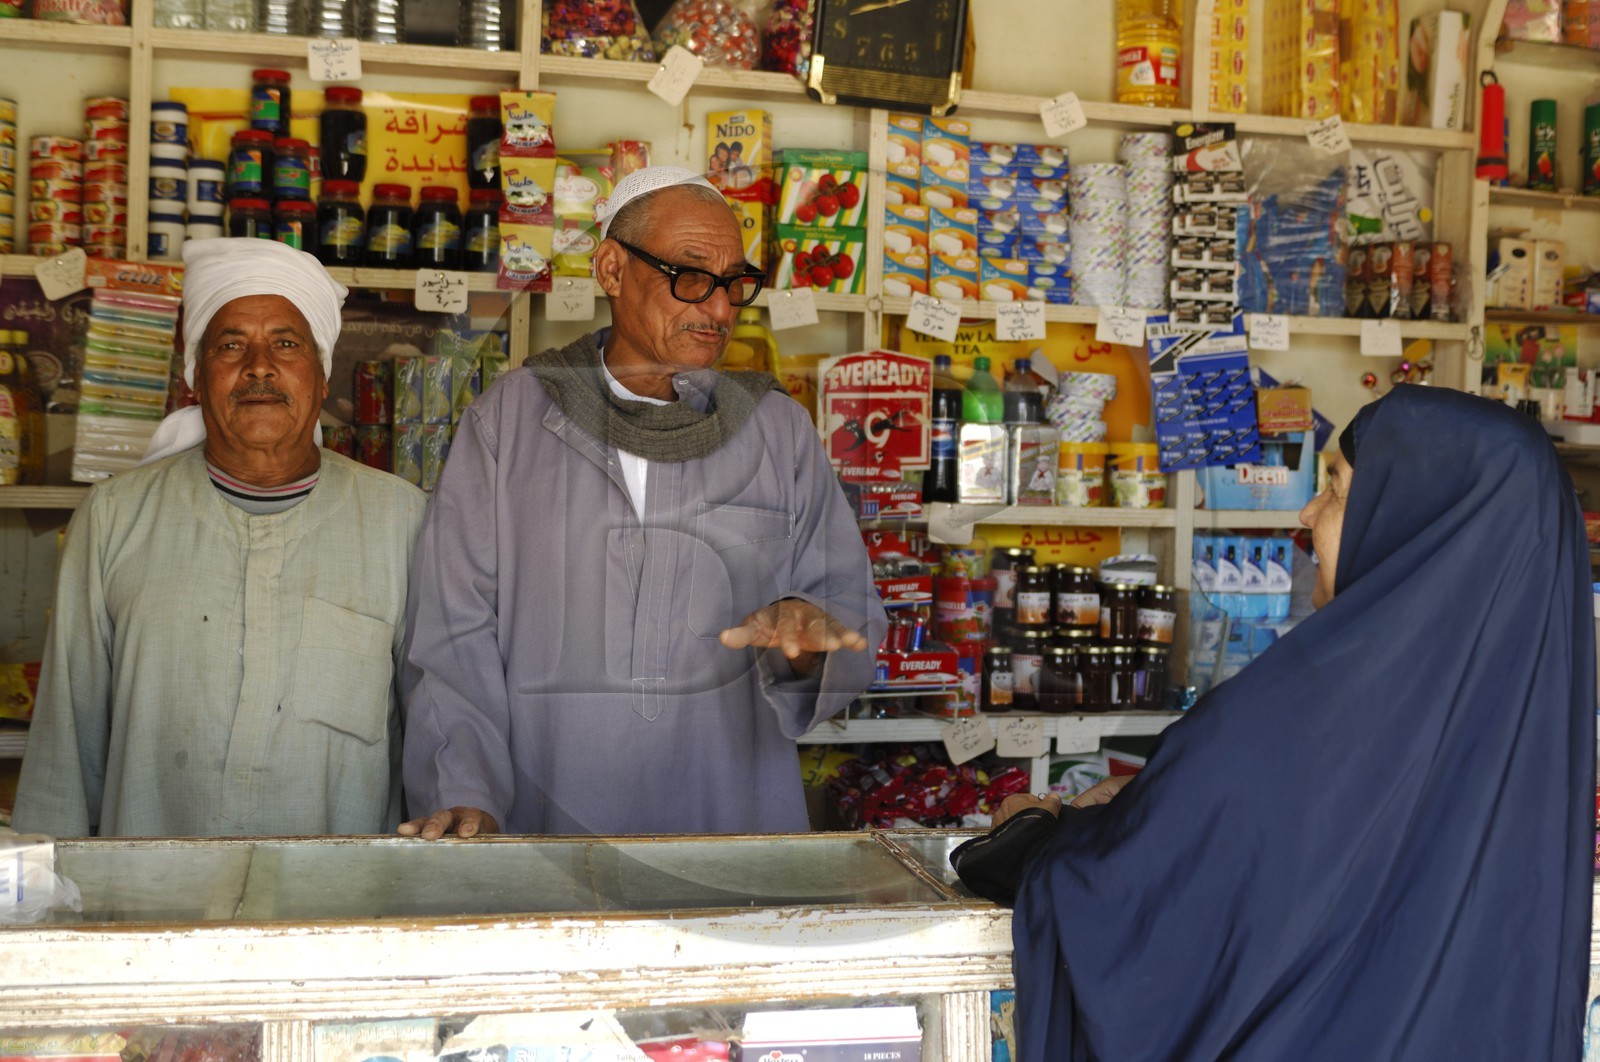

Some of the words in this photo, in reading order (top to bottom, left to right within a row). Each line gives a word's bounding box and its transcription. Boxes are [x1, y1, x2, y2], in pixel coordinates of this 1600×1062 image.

[716, 124, 756, 138] NIDO
[1185, 129, 1225, 151] Energizer
[953, 344, 980, 355] TEA
[826, 359, 926, 390] EVEREADY
[842, 466, 880, 476] EVEREADY
[1238, 466, 1289, 486] Dreem
[891, 493, 917, 501] EVEREADY
[888, 583, 920, 593] EVEREADY
[900, 660, 943, 671] EVEREADY
[873, 1051, 901, 1060] PIECES
